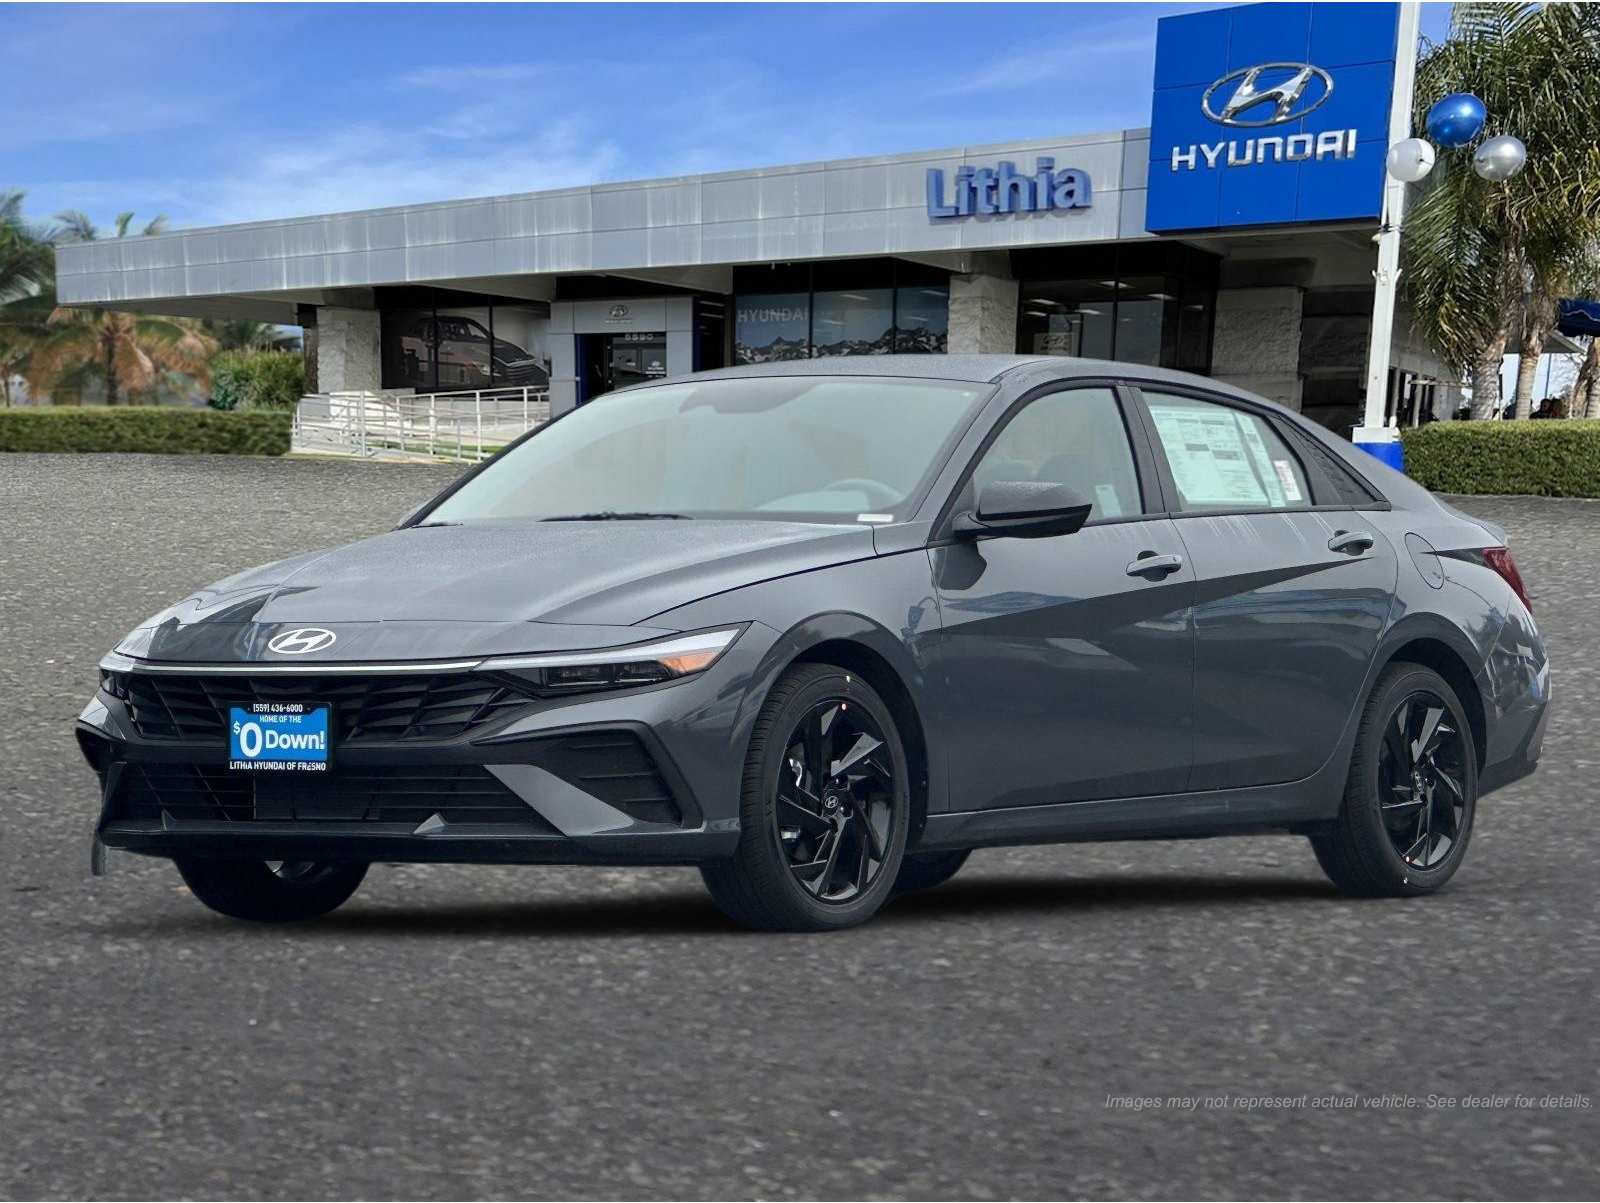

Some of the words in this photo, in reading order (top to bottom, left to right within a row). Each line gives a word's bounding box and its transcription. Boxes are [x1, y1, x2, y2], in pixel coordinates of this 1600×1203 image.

[1171, 128, 1358, 171] HYUNDAI
[926, 156, 1093, 218] Lithia
[737, 307, 808, 322] HYUNDAI
[271, 703, 303, 713] 436-6000
[260, 715, 278, 723] HOME
[279, 715, 287, 723] OF
[289, 715, 302, 724] THE
[265, 729, 326, 750] Down!
[254, 761, 285, 771] HYUNDAI
[286, 761, 296, 771] OF
[297, 761, 326, 771] FRESNO
